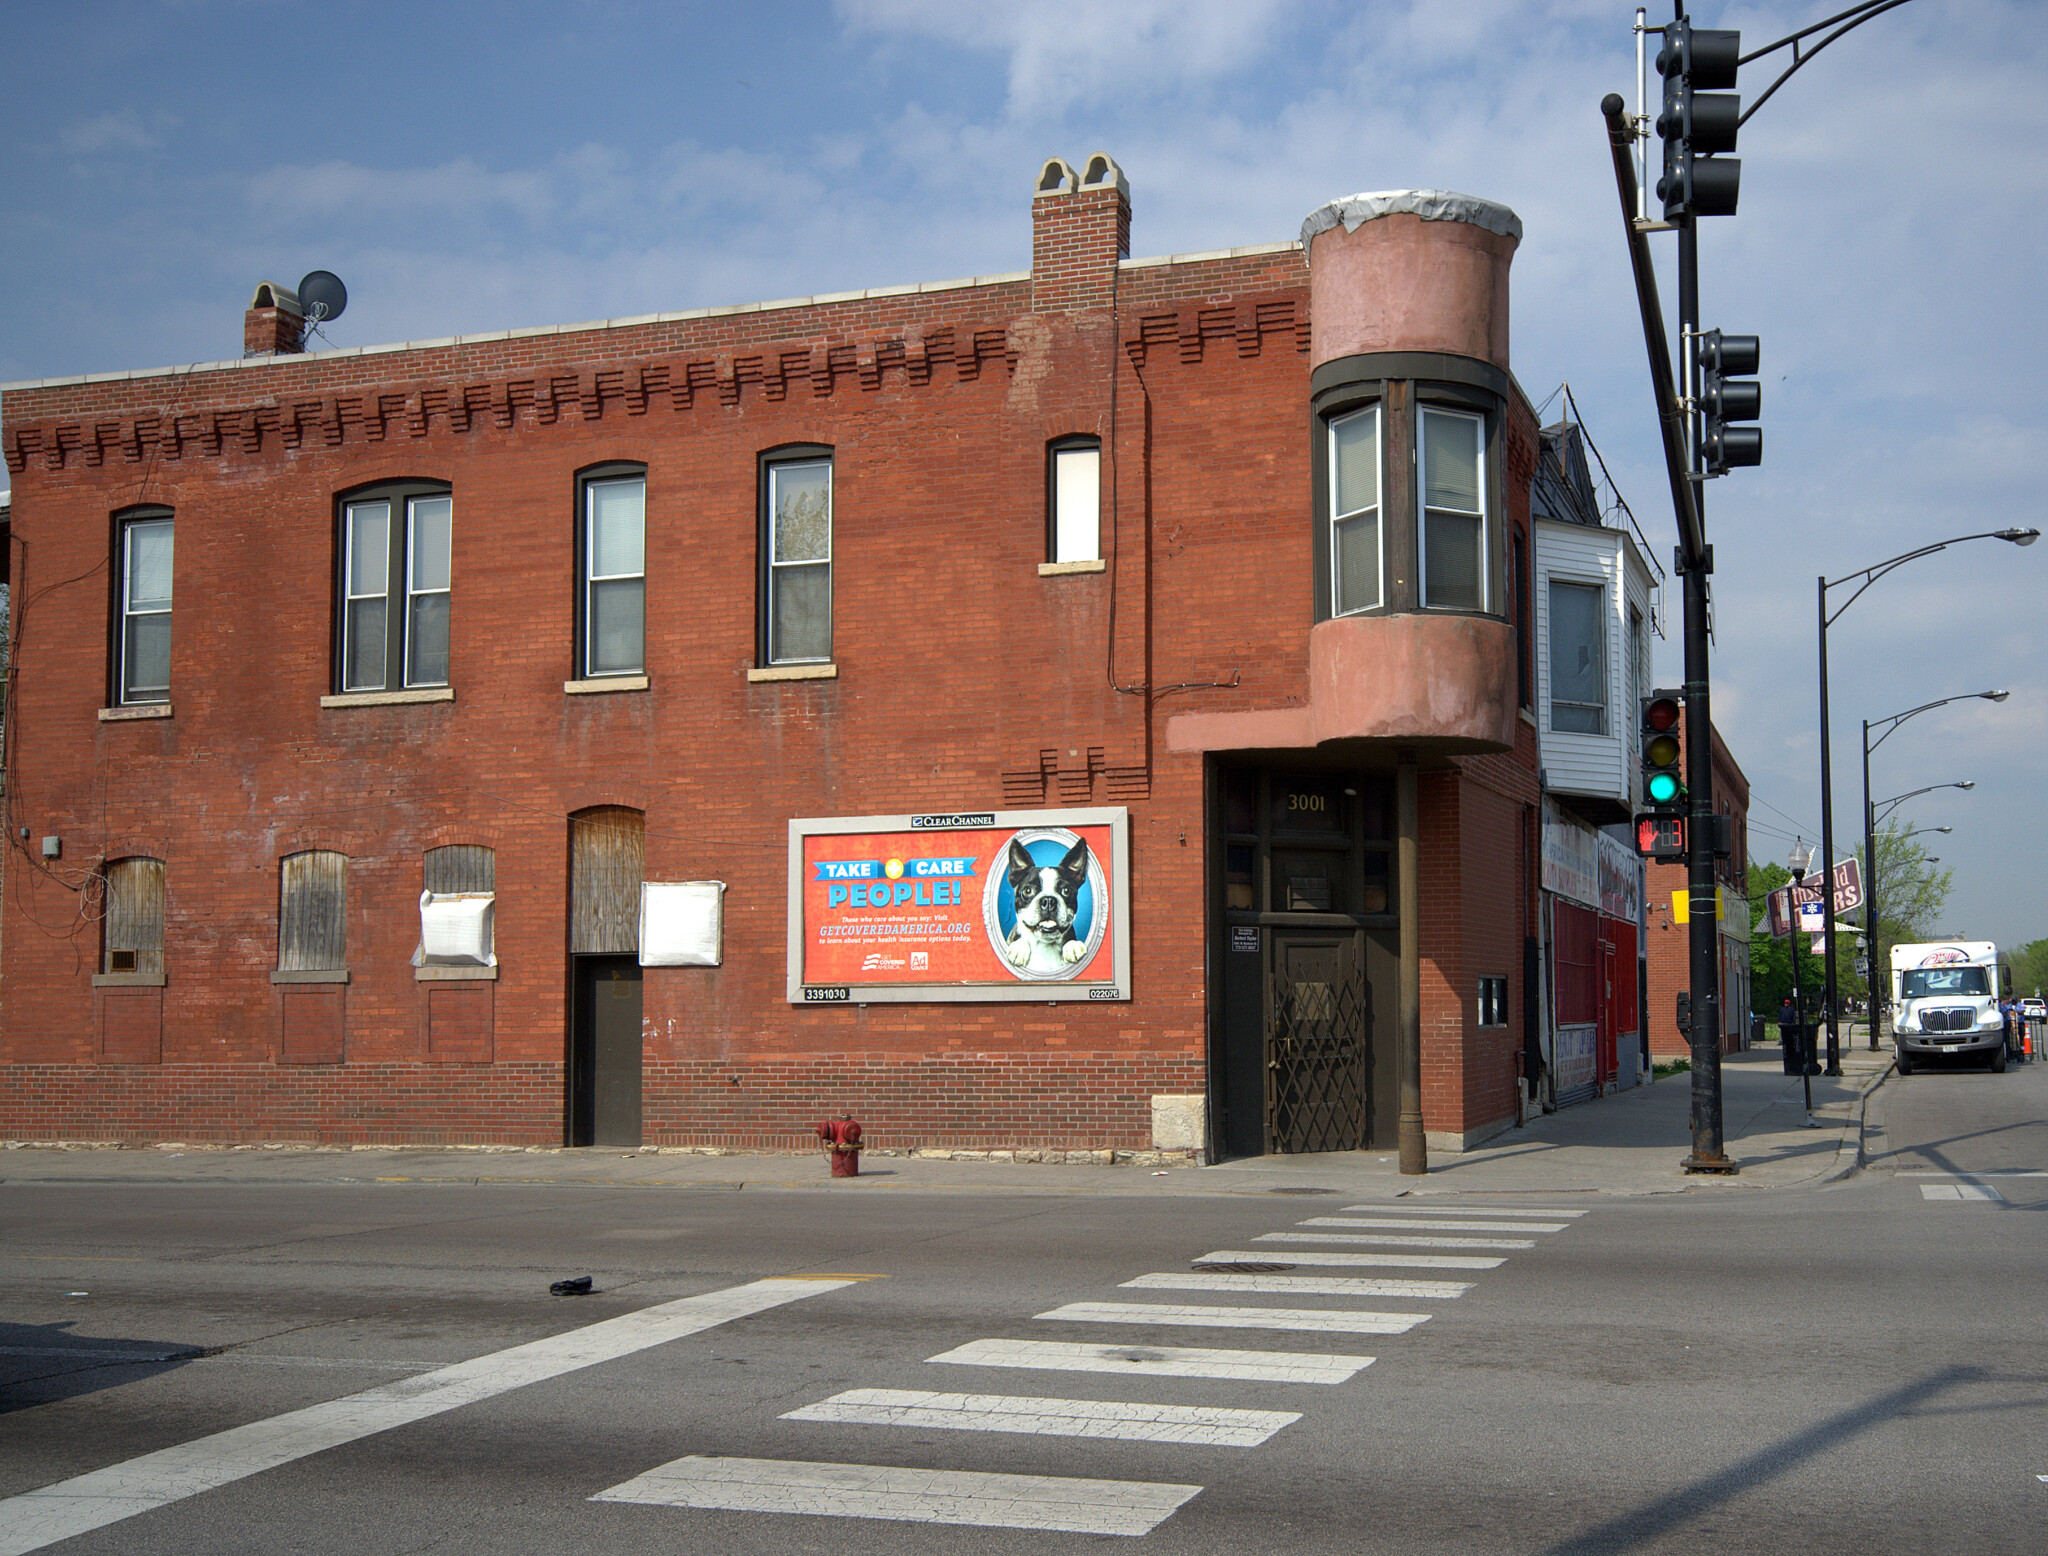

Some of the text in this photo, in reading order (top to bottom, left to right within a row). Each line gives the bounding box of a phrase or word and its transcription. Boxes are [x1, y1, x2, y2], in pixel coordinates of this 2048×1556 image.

[1288, 794, 1324, 811] 3001
[825, 860, 964, 878] TAKE CARE
[828, 880, 962, 908] PEOPLE!
[819, 922, 972, 936] GETCOVEREDAMERICA.ORG
[844, 936, 861, 944] about
[862, 937, 876, 945] your
[928, 935, 951, 943] options
[952, 935, 972, 943] today.
[912, 955, 926, 966] Ad
[806, 989, 846, 999] 3391030
